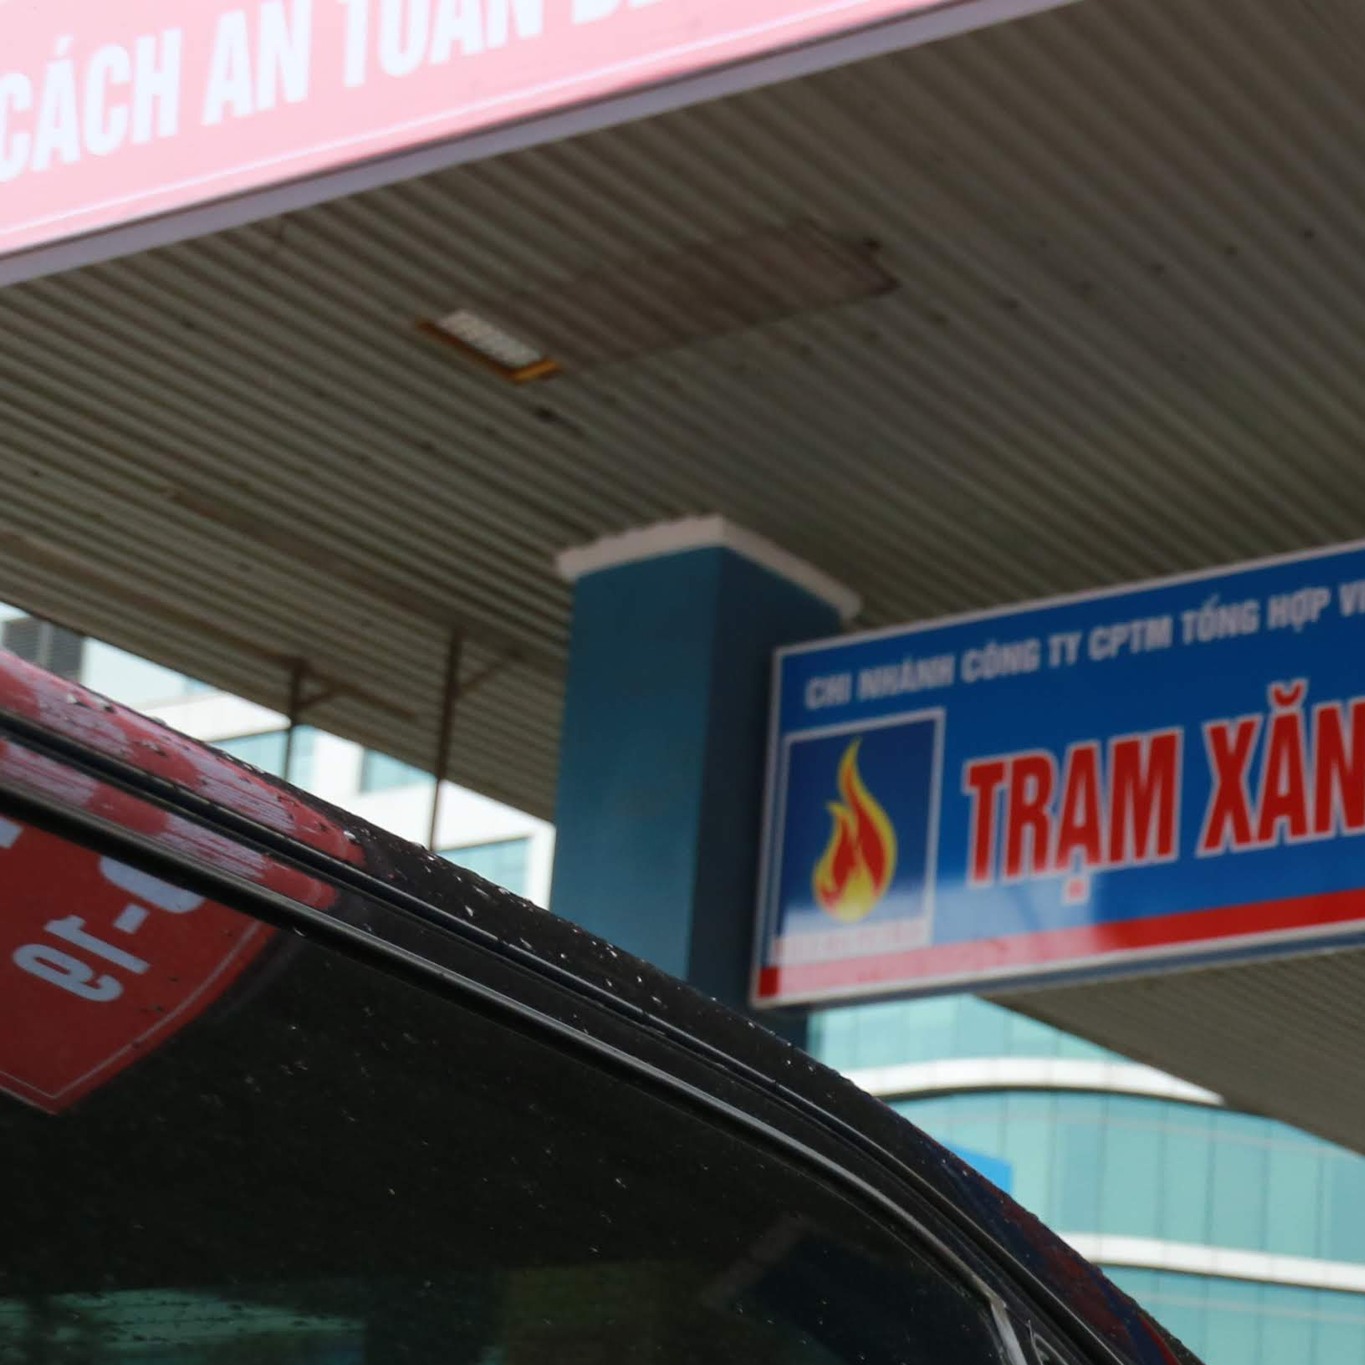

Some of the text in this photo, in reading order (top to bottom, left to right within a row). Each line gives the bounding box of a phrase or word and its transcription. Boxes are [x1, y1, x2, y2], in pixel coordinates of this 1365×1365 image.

[0, 27, 183, 183] CÁCH
[201, 0, 312, 126] AN
[804, 672, 852, 710] CHI
[857, 654, 955, 701] NHÁNH
[960, 637, 1041, 683] CÔNG
[1048, 631, 1082, 667] TY
[1088, 615, 1173, 661] CPTM
[1181, 591, 1260, 645] TỔNG
[1267, 587, 1331, 633] HỢP
[962, 726, 1184, 906] TRẠM
